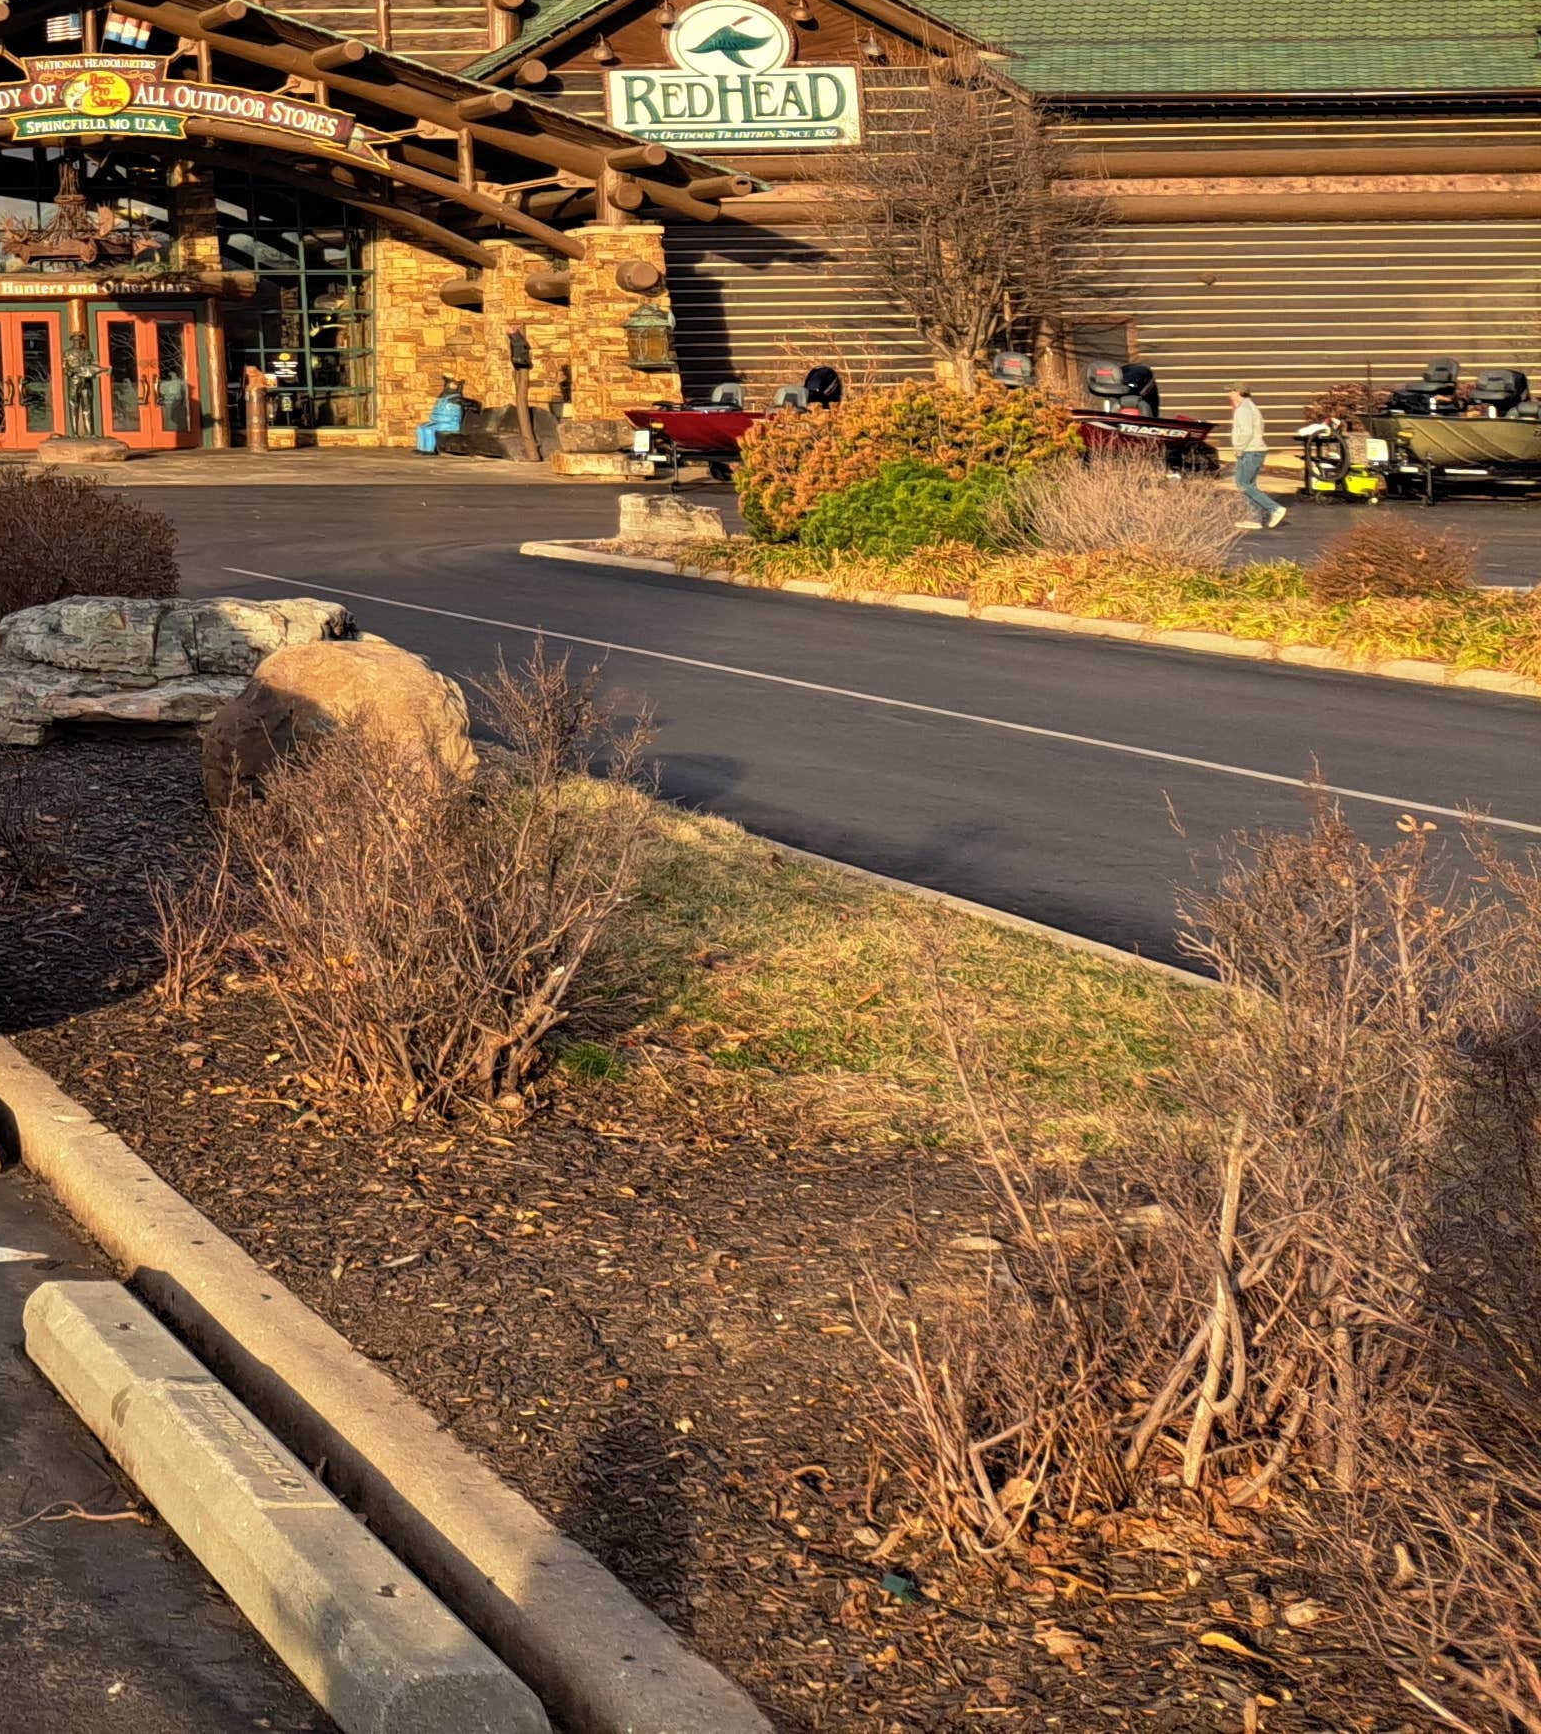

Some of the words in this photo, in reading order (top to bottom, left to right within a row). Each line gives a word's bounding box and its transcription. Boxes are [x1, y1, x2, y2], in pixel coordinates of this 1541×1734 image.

[36, 59, 83, 70] NATIONAL
[85, 58, 156, 69] HEADQUARTERS
[30, 83, 57, 106] OF
[133, 83, 169, 106] ALL
[174, 86, 265, 119] OUTDOOR
[269, 102, 339, 137] STORES
[109, 119, 130, 130] MO
[2, 282, 64, 295] Hunters
[67, 281, 98, 295] and
[102, 280, 146, 294] Other
[151, 280, 192, 294] Liars
[1118, 423, 1189, 439] TRACKER
